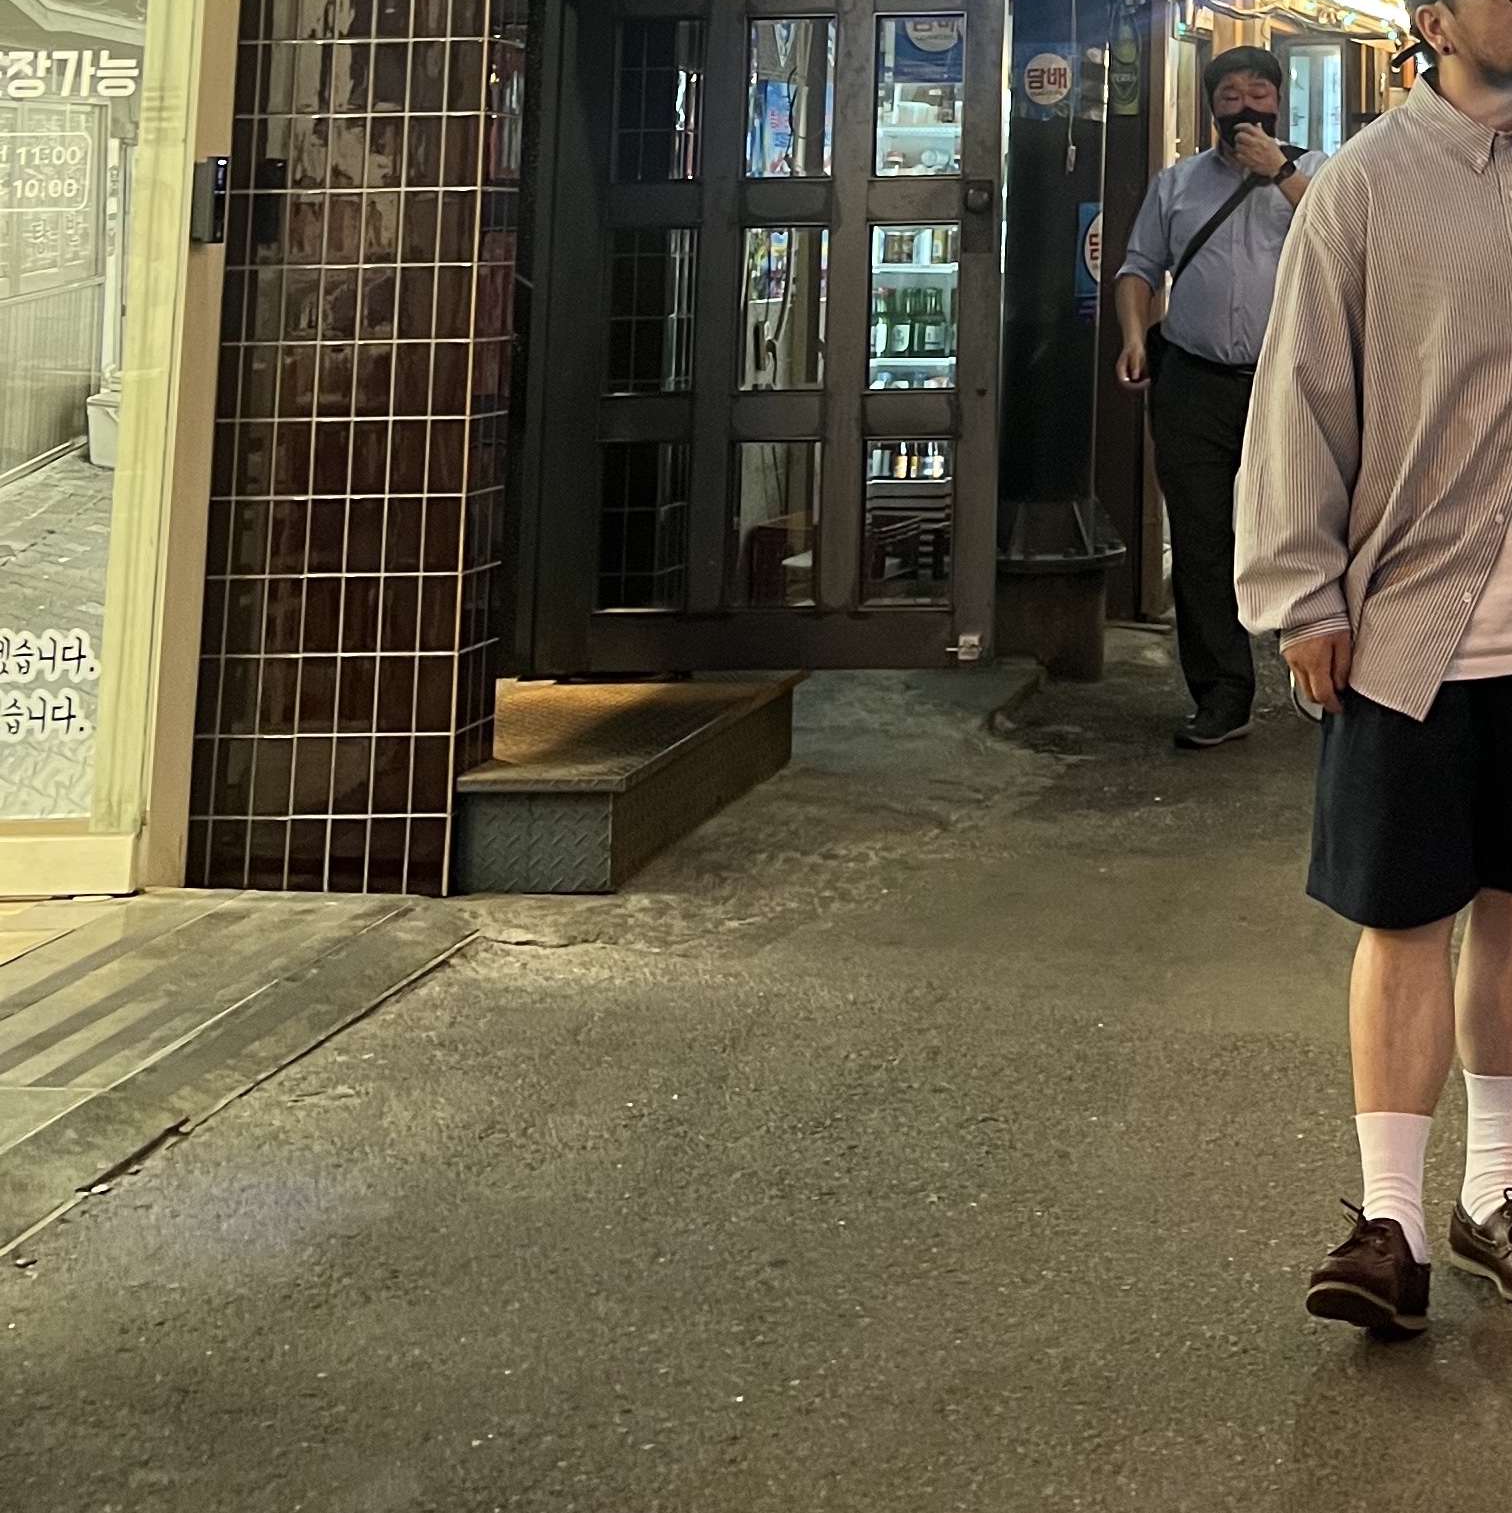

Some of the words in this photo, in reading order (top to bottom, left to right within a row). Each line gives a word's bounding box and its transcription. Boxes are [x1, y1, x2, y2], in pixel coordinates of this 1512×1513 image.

[1026, 66, 1069, 91] 담배
[16, 145, 82, 166] 11:00
[12, 178, 78, 199] 10:00
